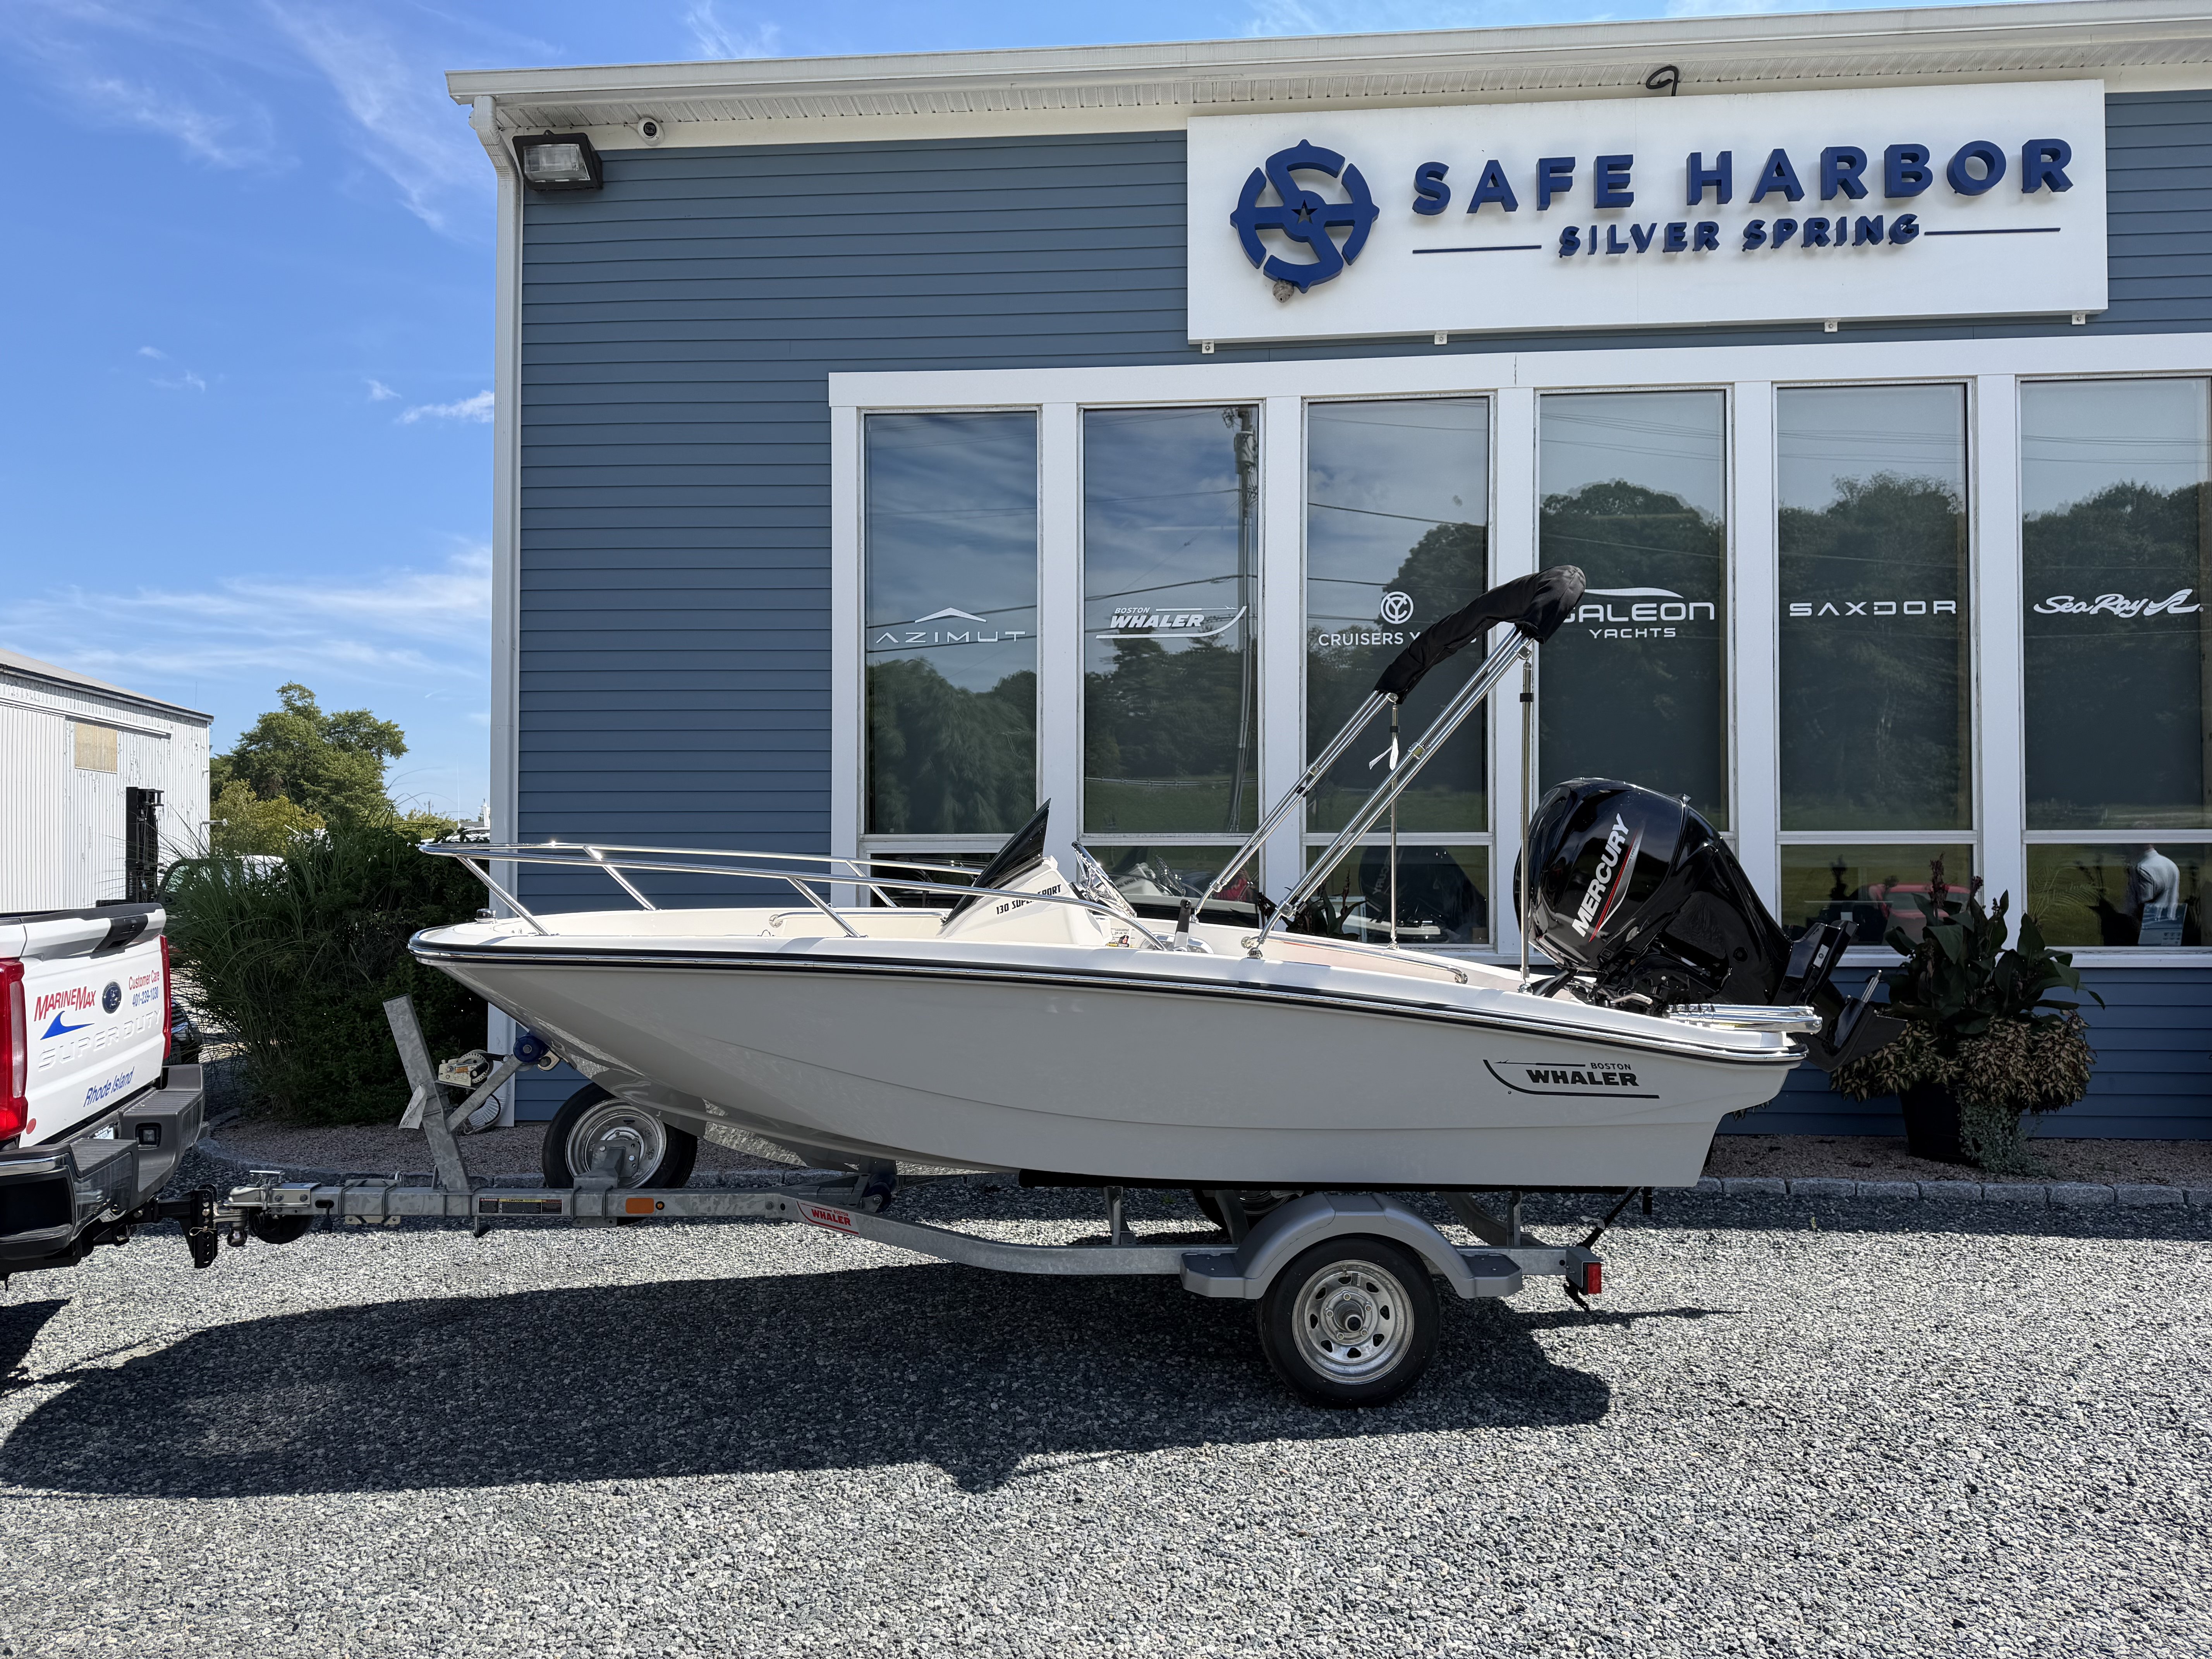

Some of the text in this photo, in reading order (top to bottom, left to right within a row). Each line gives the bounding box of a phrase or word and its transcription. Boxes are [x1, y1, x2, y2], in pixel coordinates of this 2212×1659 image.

[1413, 139, 2073, 216] SAFE HARBOR
[1559, 214, 1919, 259] SILVER SPRING
[1790, 601, 1956, 617] SAXDOR
[2033, 594, 2149, 618] Sea Ray
[1110, 614, 1205, 628] WHALER
[876, 631, 1025, 643] AZIMUT
[1318, 632, 1403, 646] CRUISERS
[1589, 628, 1676, 639] YACHTS
[1571, 813, 1629, 937] MERCURY
[996, 903, 1009, 915] 130
[1012, 899, 1034, 909] SUP
[129, 970, 160, 990] Customer Care
[38, 1008, 161, 1072] SUPER DUTY
[1590, 1062, 1632, 1070] BOSTON
[1525, 1069, 1640, 1087] WHALER
[83, 1066, 135, 1108] Rhode Island
[811, 1209, 852, 1226] WHALER
